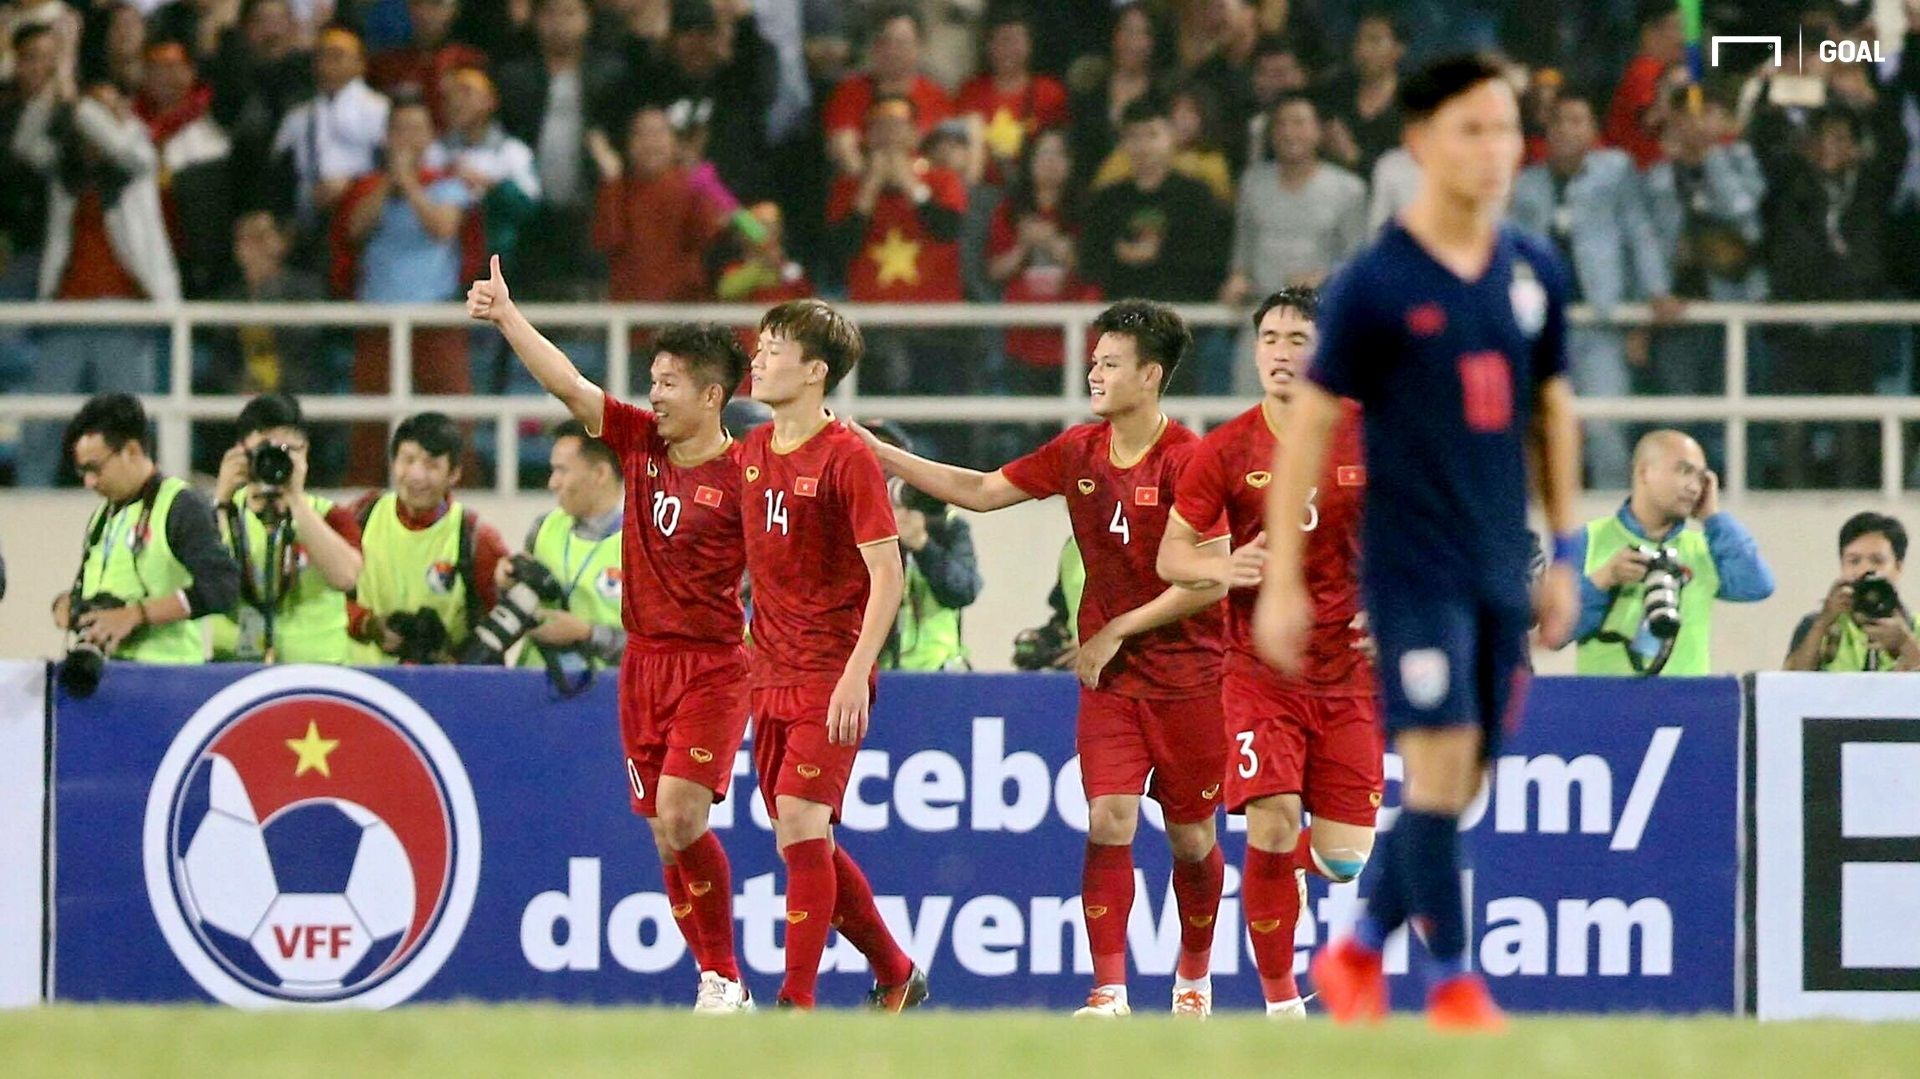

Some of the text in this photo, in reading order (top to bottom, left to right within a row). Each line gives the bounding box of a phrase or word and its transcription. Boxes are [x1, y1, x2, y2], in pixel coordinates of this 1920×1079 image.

[653, 491, 681, 536] 10
[764, 488, 788, 535] 14
[1109, 501, 1131, 544] 4
[1235, 730, 1259, 779] 3
[273, 925, 352, 959] VFF
